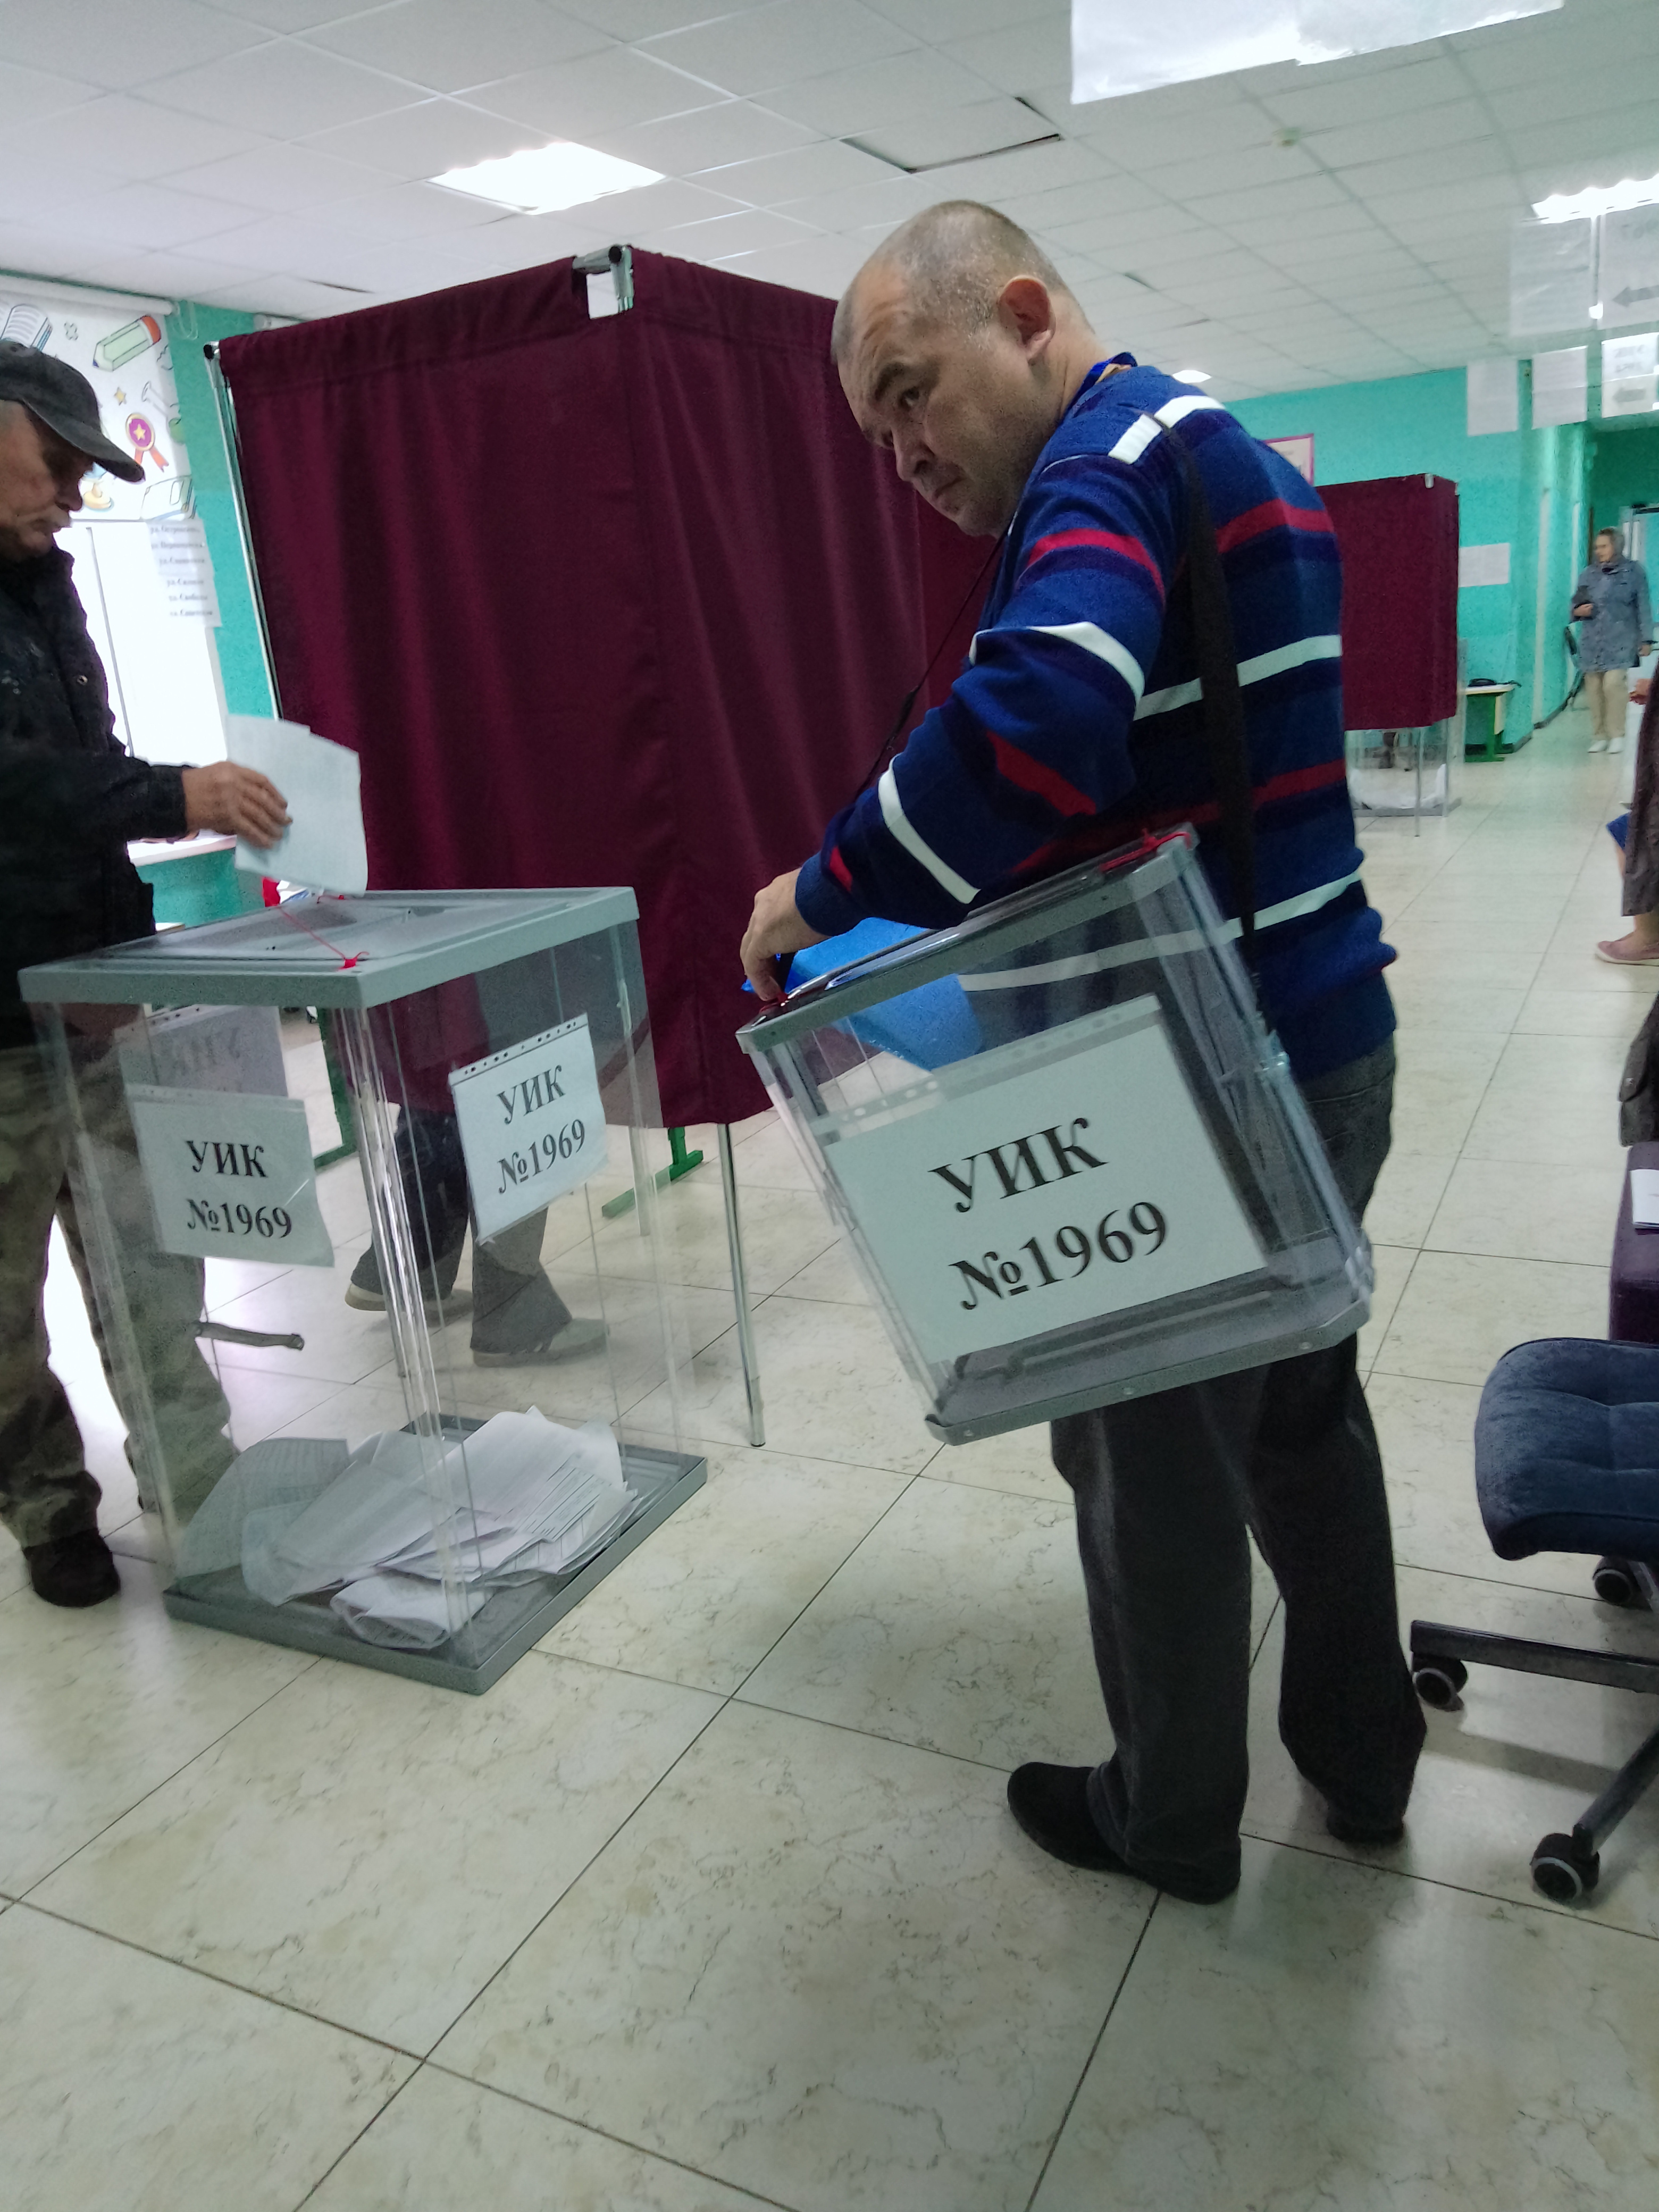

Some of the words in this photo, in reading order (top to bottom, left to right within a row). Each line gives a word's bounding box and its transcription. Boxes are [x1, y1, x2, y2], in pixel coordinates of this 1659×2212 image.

[497, 1065, 566, 1125] УИК
[185, 1141, 269, 1178] УИК
[498, 1119, 586, 1195] №1969
[927, 1117, 1109, 1213] УИК
[187, 1199, 292, 1239] №1969
[948, 1202, 1167, 1311] №1969
